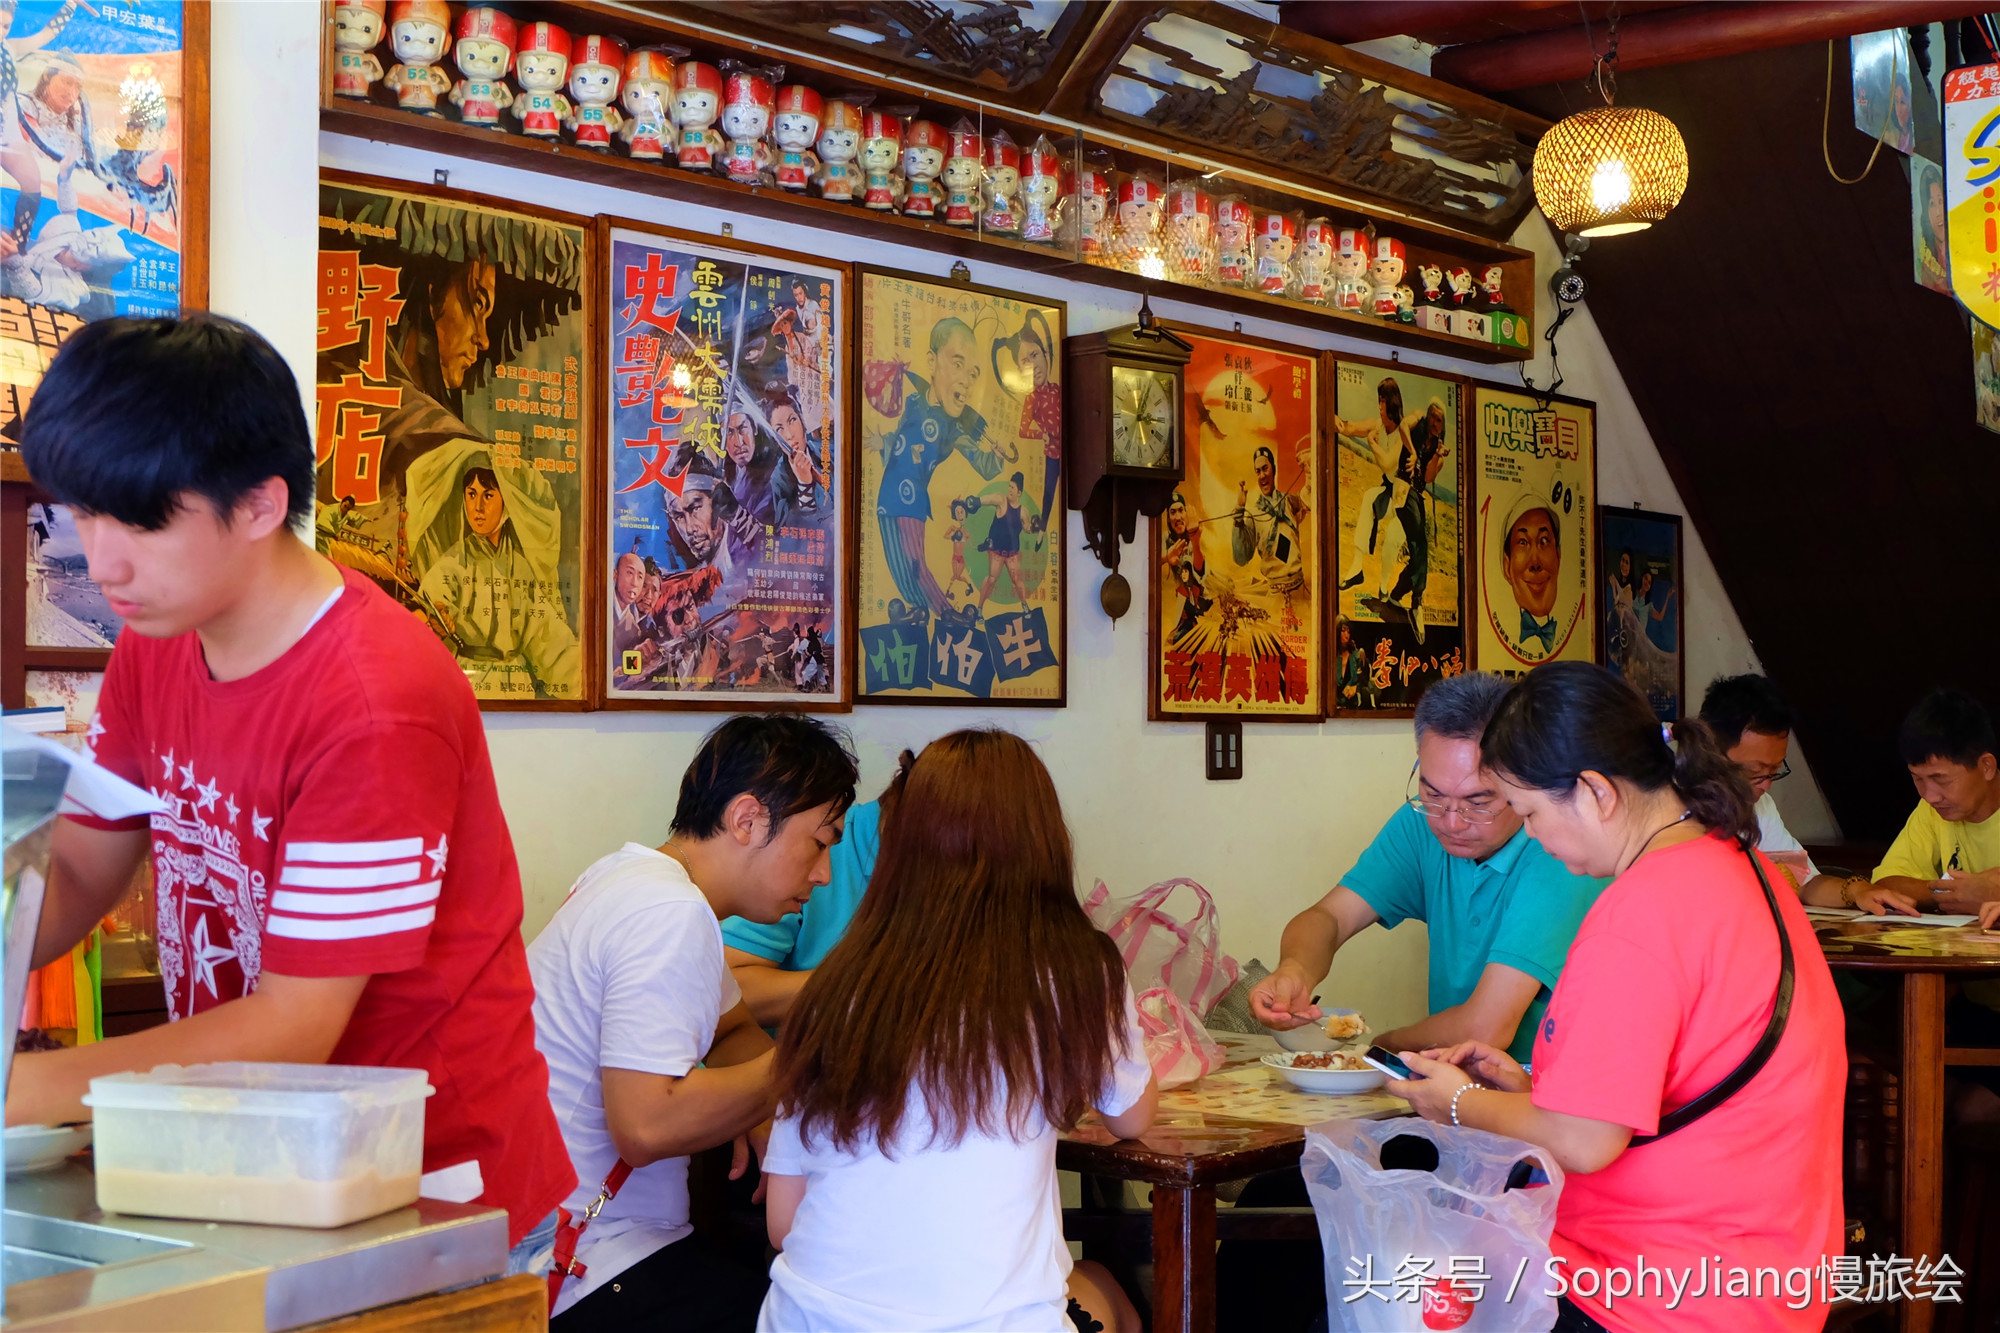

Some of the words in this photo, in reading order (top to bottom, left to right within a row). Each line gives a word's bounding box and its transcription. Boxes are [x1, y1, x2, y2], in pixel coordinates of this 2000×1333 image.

[342, 55, 361, 67] 51
[407, 68, 428, 79] 52
[471, 84, 491, 95] 53
[532, 97, 552, 109] 54
[583, 108, 603, 121] 55
[684, 131, 703, 143] 58
[784, 153, 802, 165] 60
[830, 166, 846, 177] 61
[911, 183, 929, 194] 63
[1484, 402, 1579, 461] 快樂寶貝
[1281, 635, 1308, 644] BORDER
[472, 664, 487, 672] THE
